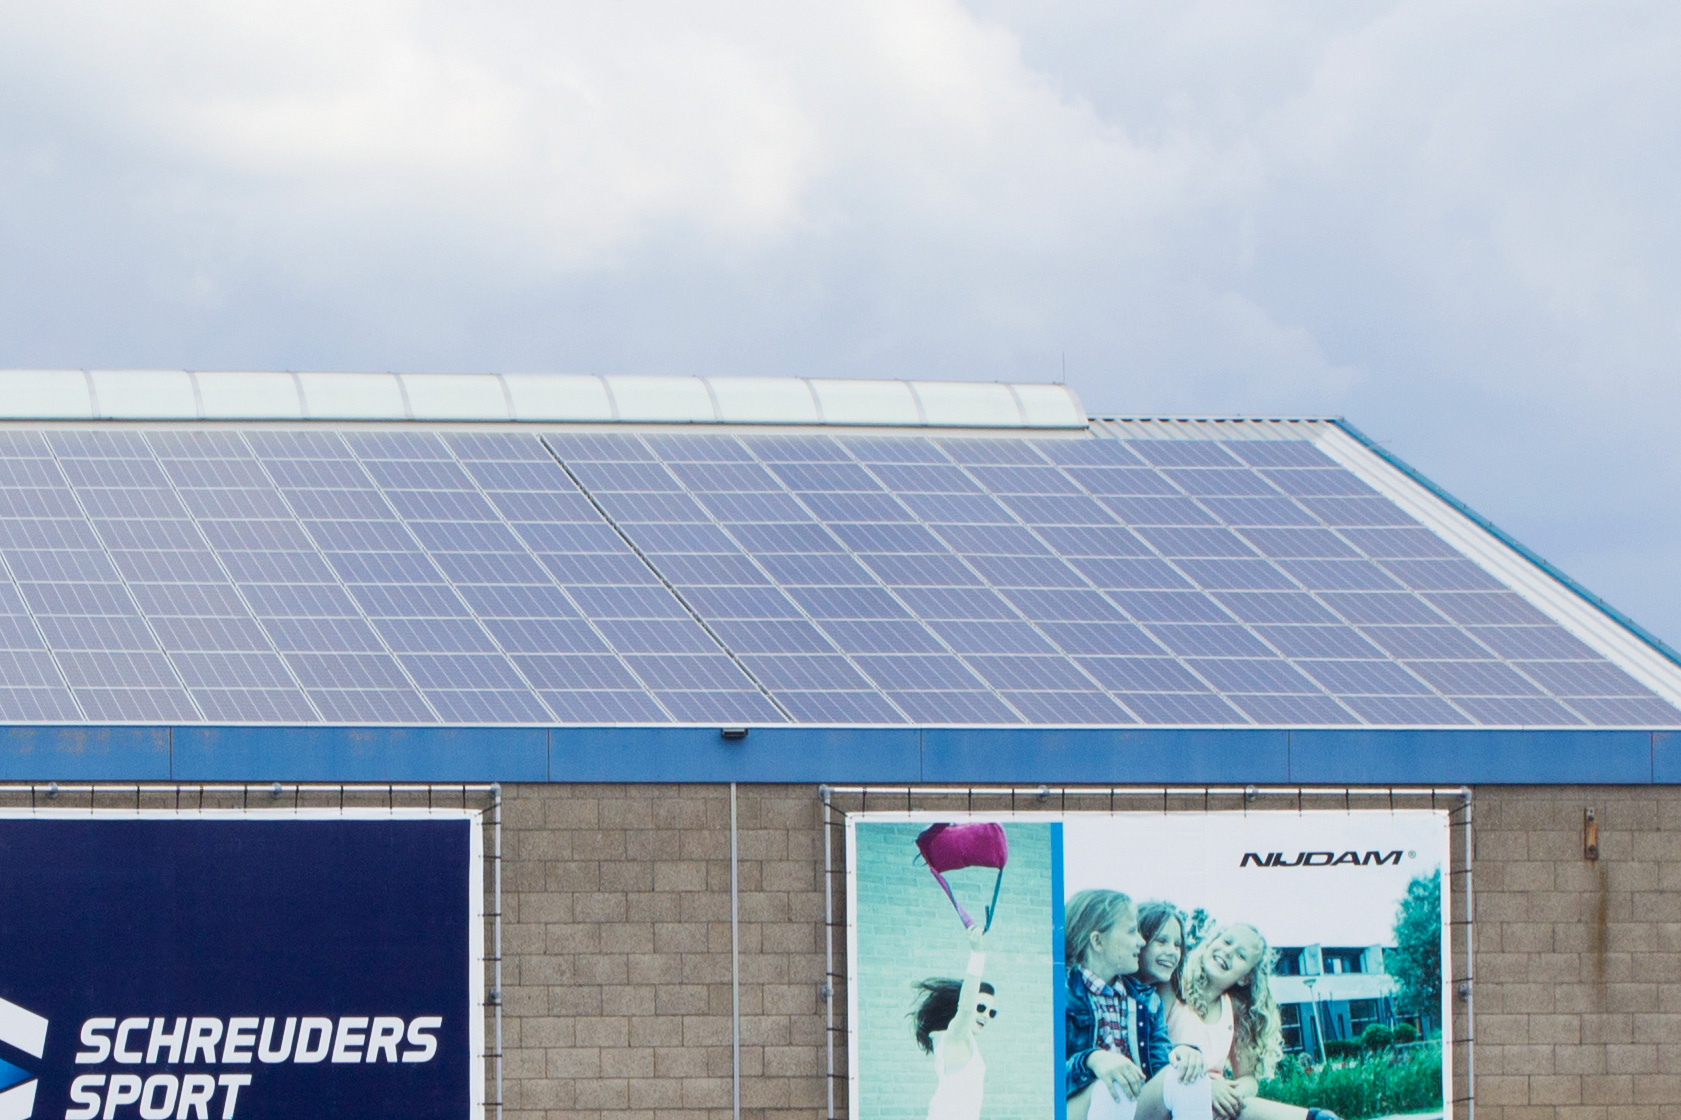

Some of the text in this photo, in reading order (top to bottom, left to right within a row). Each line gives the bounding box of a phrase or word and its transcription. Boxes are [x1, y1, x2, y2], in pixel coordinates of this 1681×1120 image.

[1239, 850, 1404, 868] NIJDAM
[75, 1016, 443, 1064] SCHREUDERS
[64, 1074, 252, 1120] SPORT
